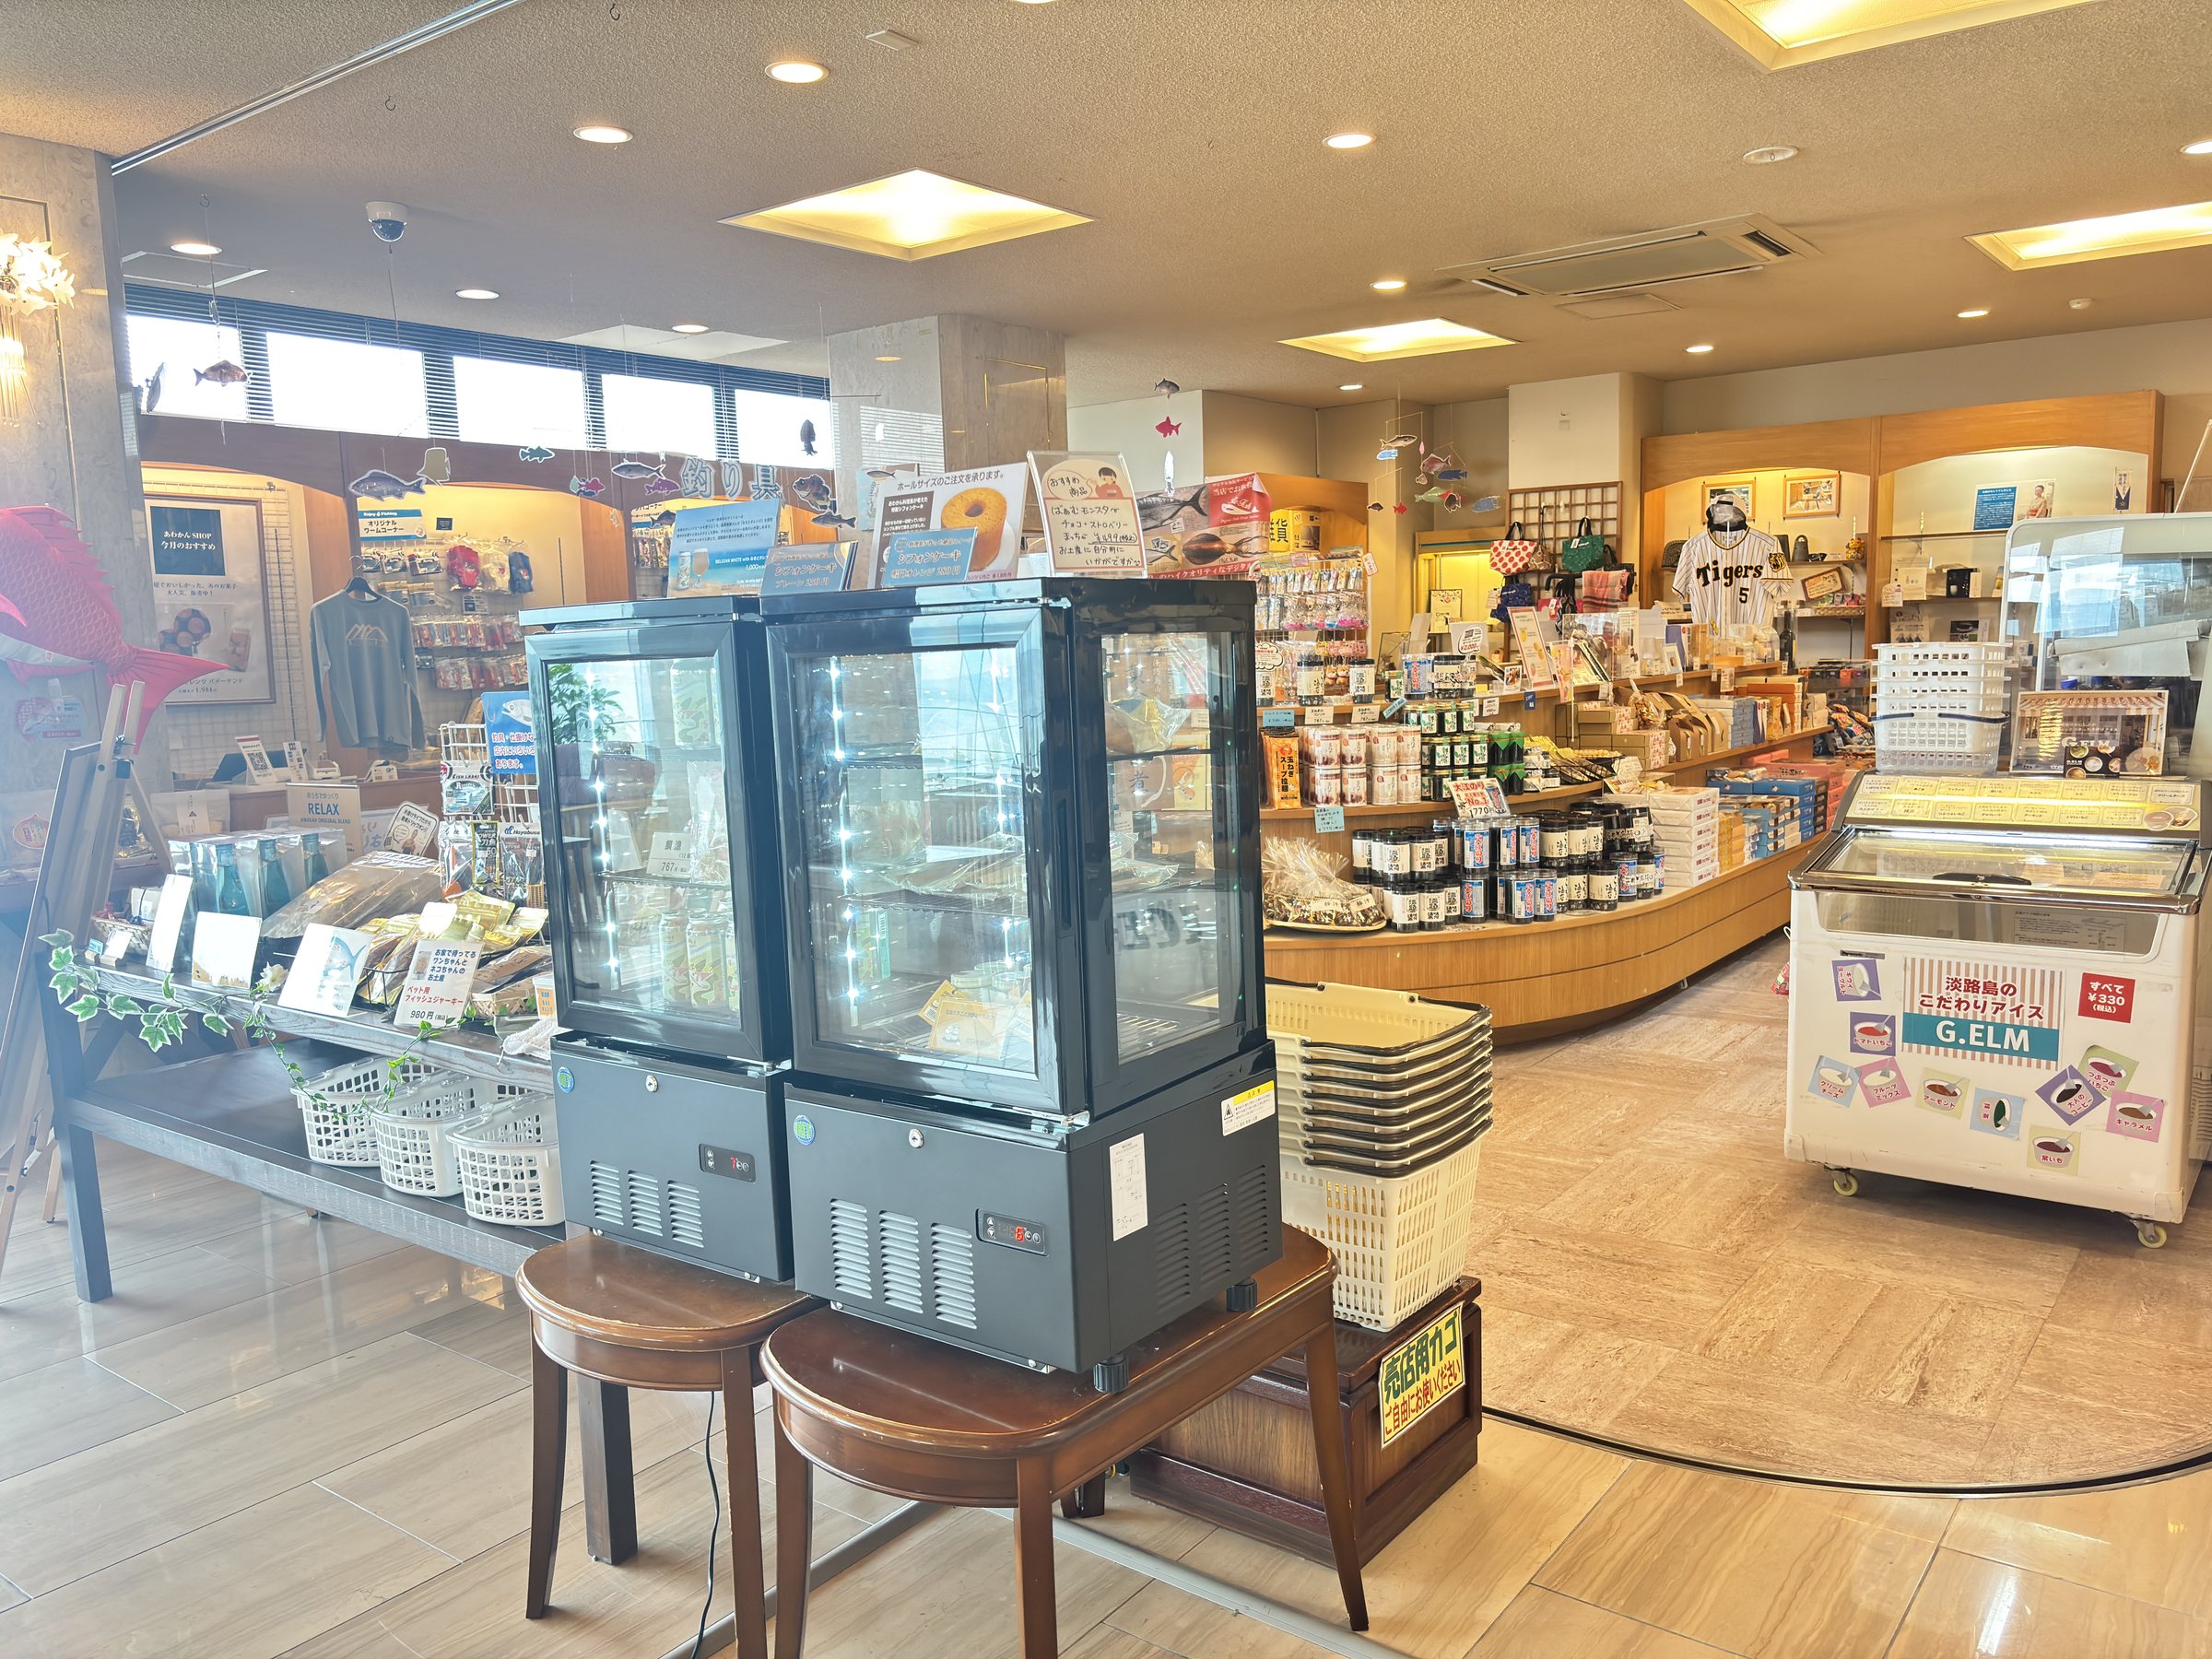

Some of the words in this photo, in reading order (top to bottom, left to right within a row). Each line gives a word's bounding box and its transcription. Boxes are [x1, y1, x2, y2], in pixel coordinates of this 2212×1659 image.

[681, 458, 784, 500] 釣り具
[898, 470, 1004, 491] ホールサイズのご注文を承ります。
[1051, 477, 1080, 487] おすすめ
[1069, 487, 1088, 498] 商品
[160, 541, 216, 551] 今月のおすすめ
[1059, 545, 1091, 555] お土産に
[1094, 545, 1124, 554] 自分用に
[898, 550, 961, 565] シフォンケーキ
[1086, 556, 1133, 566] いかがですか
[774, 562, 837, 576] シフォンケーキ
[1696, 559, 1764, 588] Tigers
[1739, 587, 1749, 604] 5
[494, 746, 535, 755] 店内にいろいろ
[495, 759, 524, 769] あります。
[1280, 757, 1288, 793] スープ拉麺
[1453, 781, 1485, 792] 大江のり
[1467, 796, 1488, 806] No.1
[308, 803, 340, 815] RELAX
[434, 948, 477, 959] お家で待ってる
[432, 957, 467, 966] ワンちゃんと
[429, 966, 465, 974] ネコちゃんの
[427, 974, 444, 982] お土産
[1837, 966, 1846, 995] ヨーグルト
[407, 986, 430, 994] ペット用
[1946, 976, 2018, 997] 淡路島の
[2089, 982, 2124, 994] すべて
[405, 994, 464, 1005] フィッシュジャーキー
[2088, 992, 2125, 1006] ¥330
[1919, 994, 2044, 1020] こだわりアイス
[2092, 1004, 2117, 1014] (税込)
[1853, 1037, 1892, 1047] トマトいちご
[1936, 1020, 2030, 1052] G.ELM
[2088, 1071, 2116, 1087] つぶつぶ
[2088, 1078, 2109, 1092] いちご
[1820, 1079, 1844, 1094] クリーム
[1873, 1083, 1897, 1095] フルーツ
[1821, 1088, 1841, 1100] チーズ
[1876, 1090, 1900, 1101] ミックス
[1924, 1094, 1956, 1109] アーモンド
[2067, 1093, 2086, 1109] 大人の
[2070, 1098, 2093, 1116] コーヒー
[2115, 1118, 2153, 1132] キャラメル
[2041, 1155, 2064, 1164] 紫いも
[1384, 1310, 1458, 1405] 売店用カゴ
[1385, 1359, 1461, 1436] ご自由にお使いください
